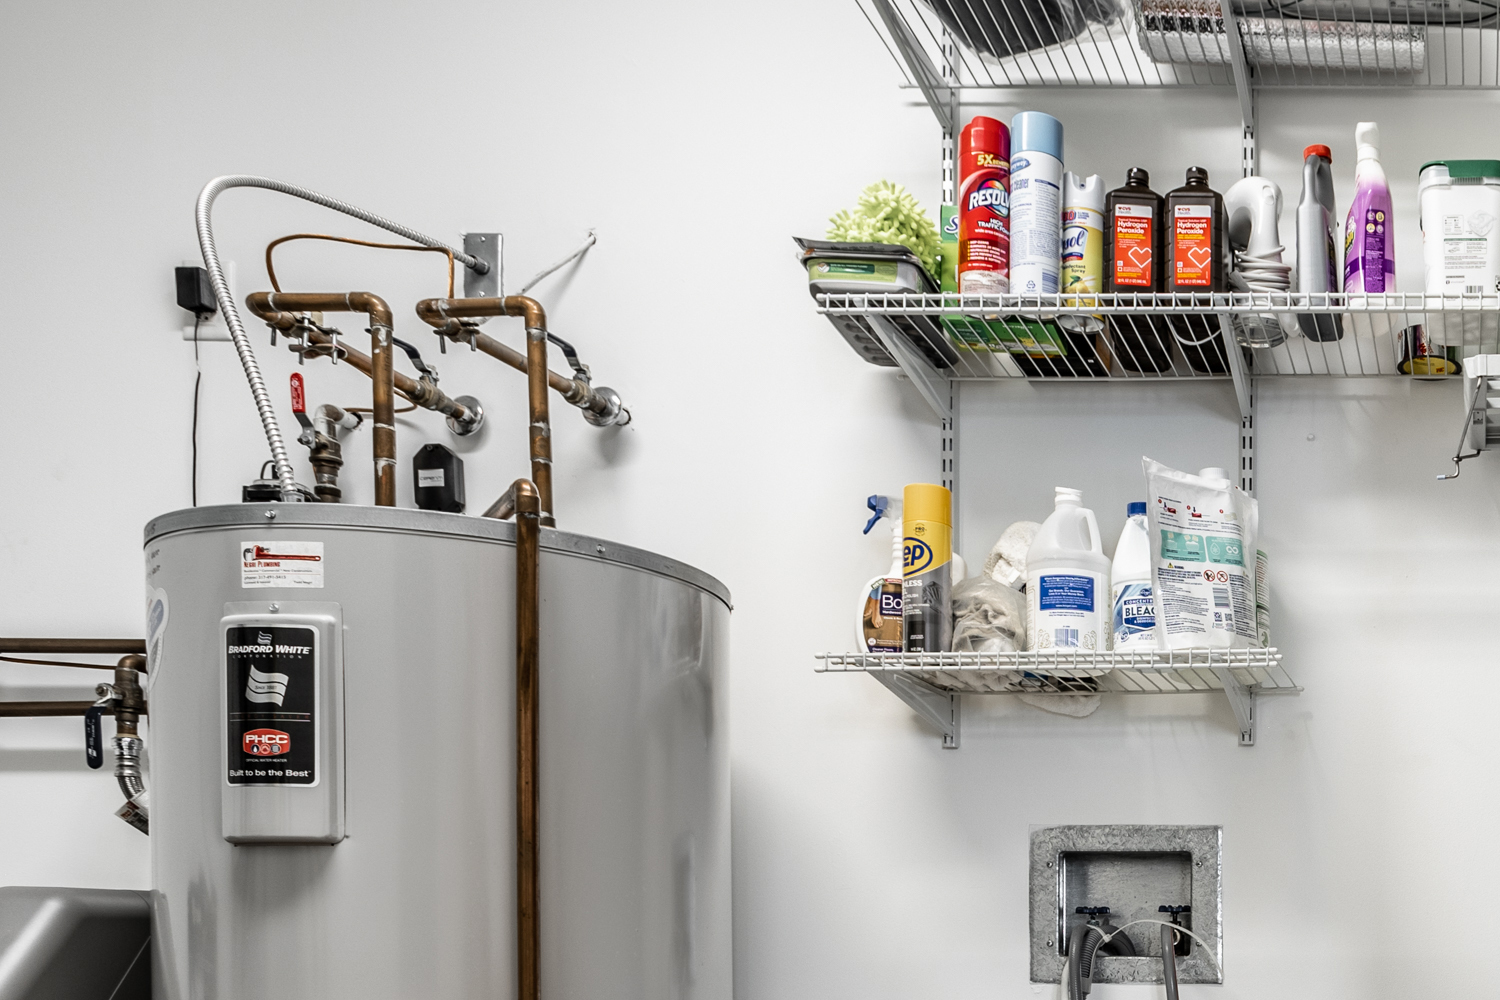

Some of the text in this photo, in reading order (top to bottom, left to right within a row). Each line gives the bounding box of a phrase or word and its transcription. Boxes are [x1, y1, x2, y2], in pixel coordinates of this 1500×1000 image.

[977, 154, 993, 165] 5X
[968, 188, 1010, 211] RESOLV
[903, 545, 925, 566] ep
[882, 595, 902, 609] Bo
[1125, 607, 1155, 616] BLEAC
[228, 645, 310, 654] BRADFORD WHITE
[246, 735, 288, 743] PHCC
